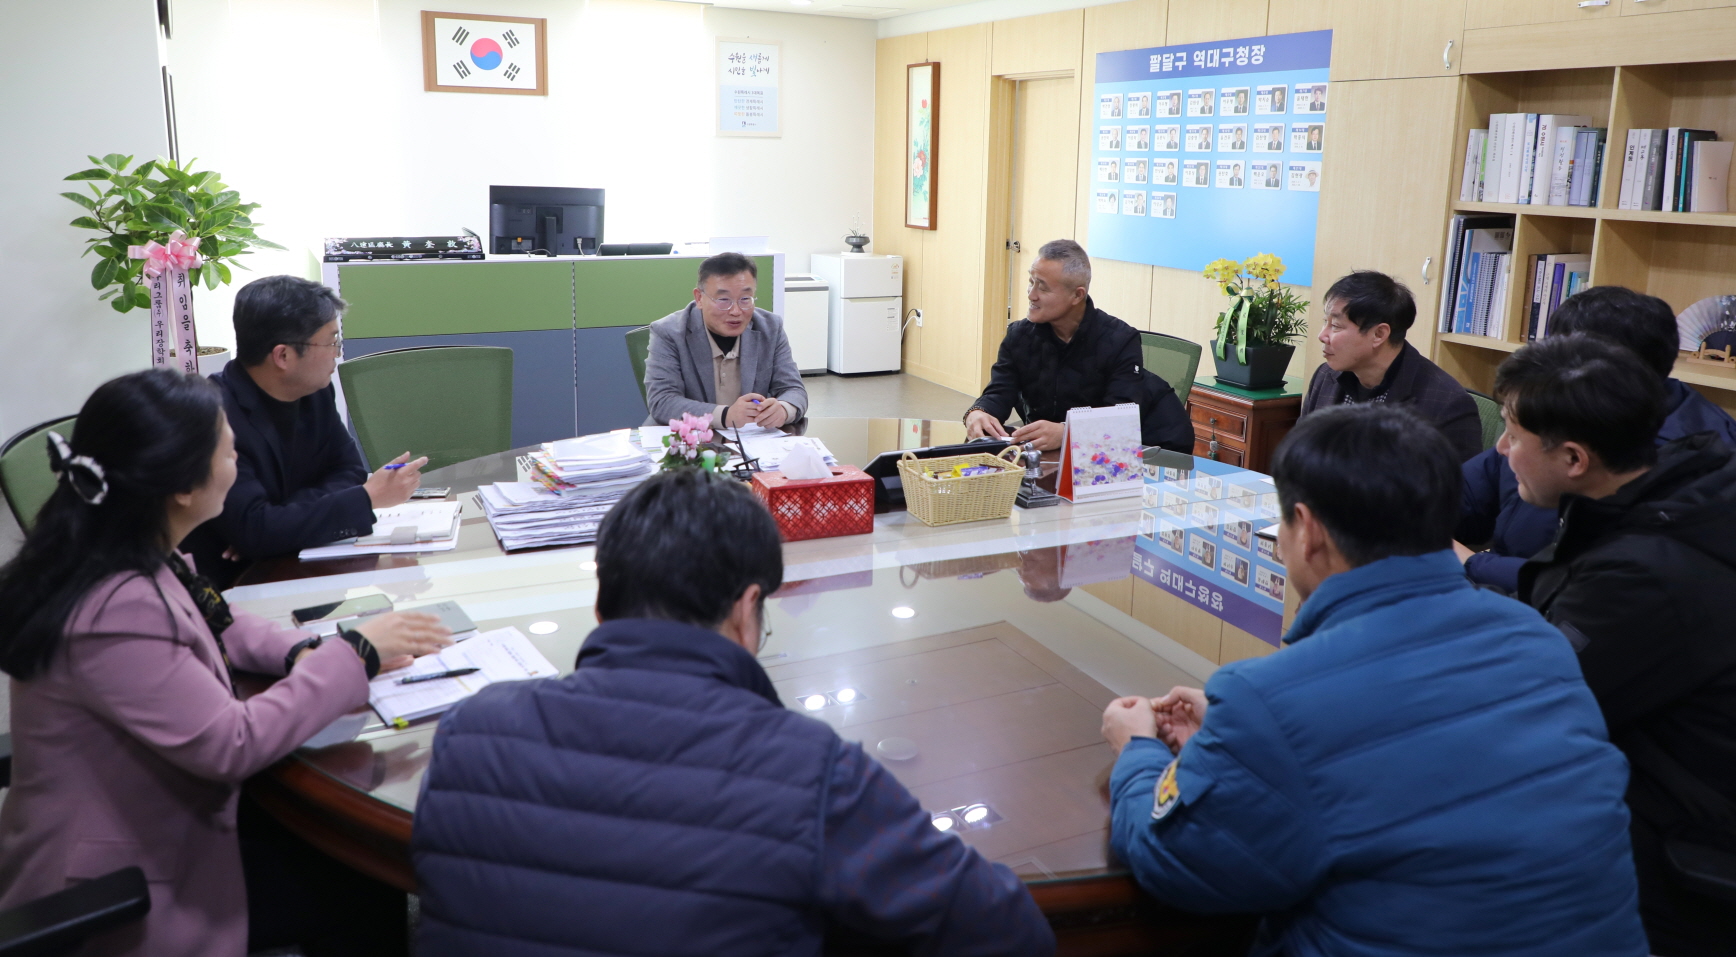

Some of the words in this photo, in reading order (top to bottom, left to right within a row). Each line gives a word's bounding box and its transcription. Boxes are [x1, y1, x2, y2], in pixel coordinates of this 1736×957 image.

[728, 52, 747, 64] 수원을
[749, 52, 770, 64] 새롭게
[1149, 52, 1187, 73] 팔달구
[1193, 44, 1266, 69] 역대구청장
[728, 66, 746, 76] 시민을
[749, 65, 770, 77] 빛나게
[1627, 144, 1636, 162] 인계동
[177, 272, 191, 331] 취임을
[154, 320, 166, 365] 우리장학회
